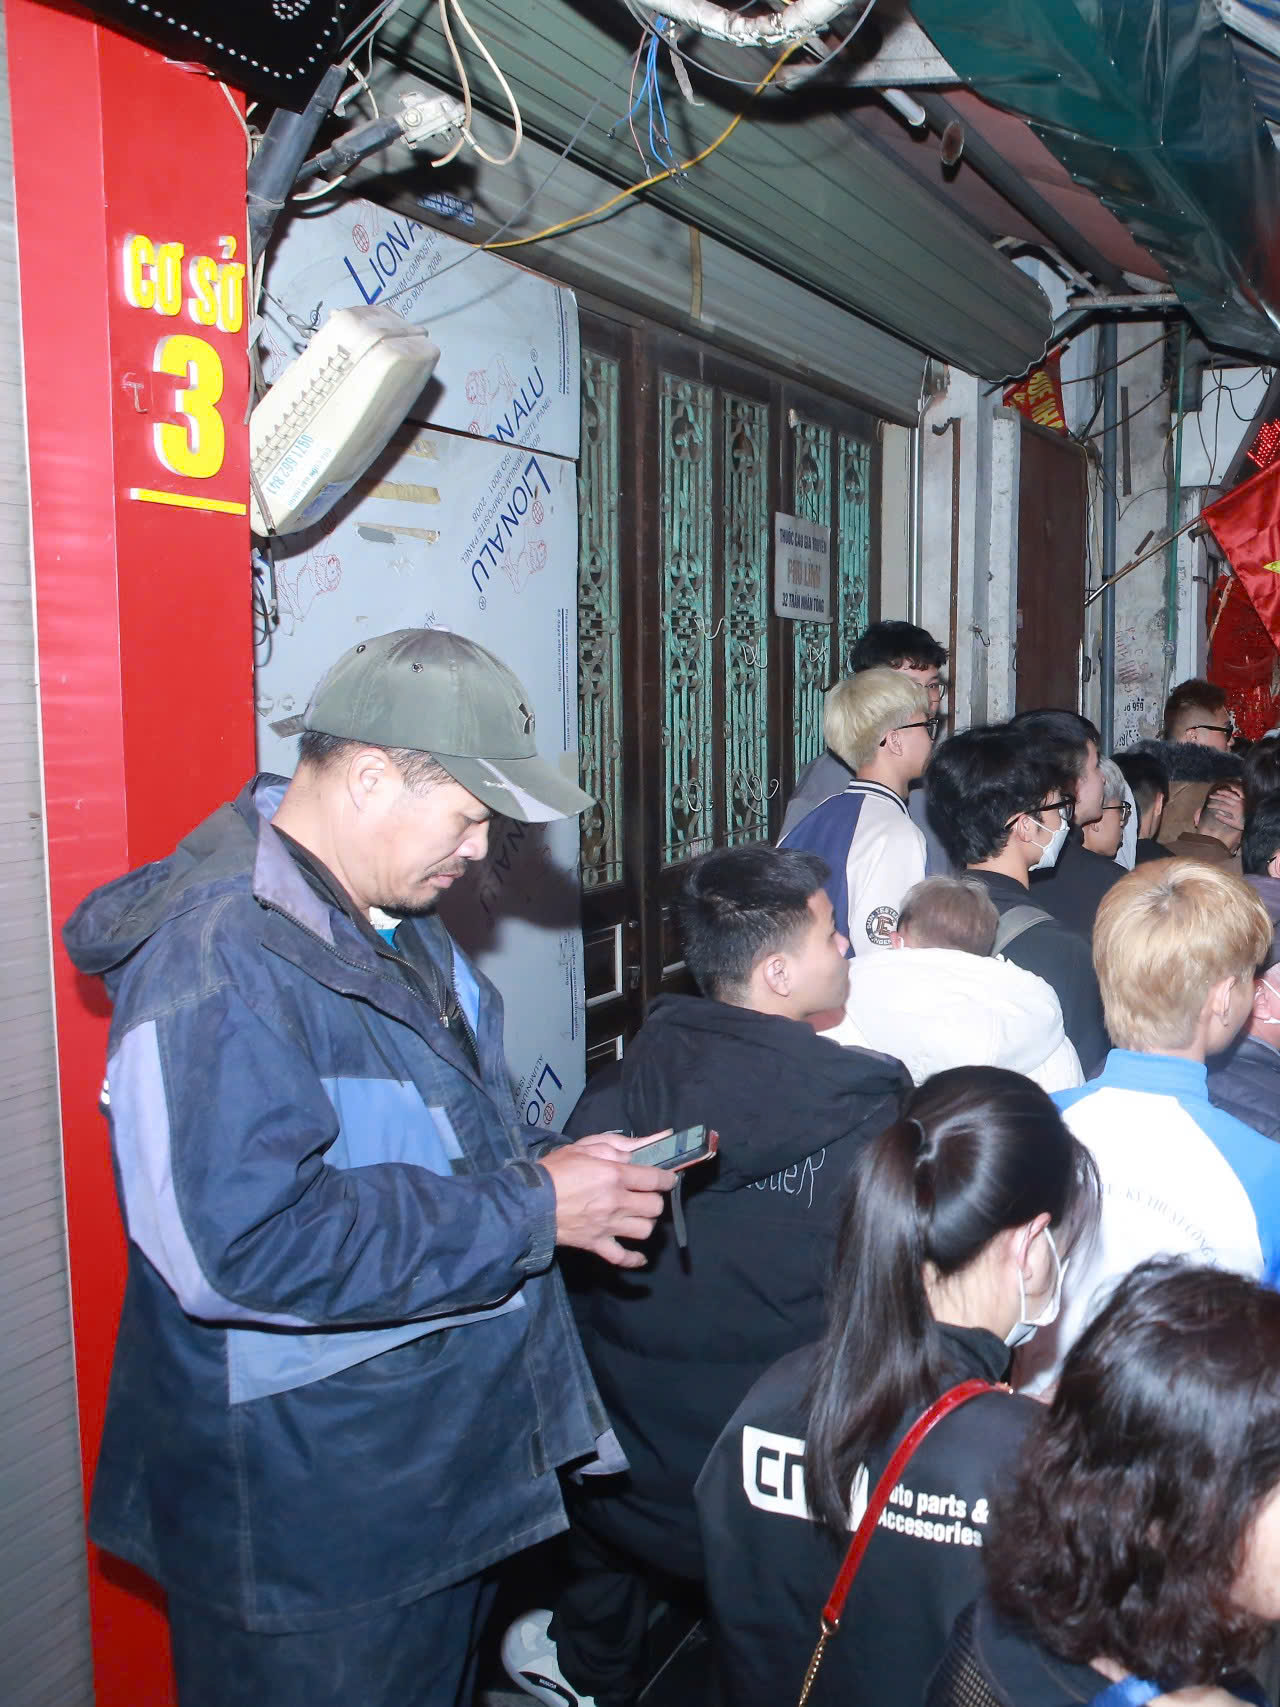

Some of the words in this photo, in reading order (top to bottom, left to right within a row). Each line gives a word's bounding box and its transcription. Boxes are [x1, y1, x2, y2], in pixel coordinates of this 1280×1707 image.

[123, 233, 184, 316] CƠ
[188, 235, 245, 333] SỞ
[152, 334, 225, 478] 3
[471, 456, 551, 592] LIONALU
[878, 1506, 984, 1547] Accessories
[889, 1483, 914, 1503] uto
[917, 1491, 967, 1519] parts
[971, 1498, 990, 1524] &
